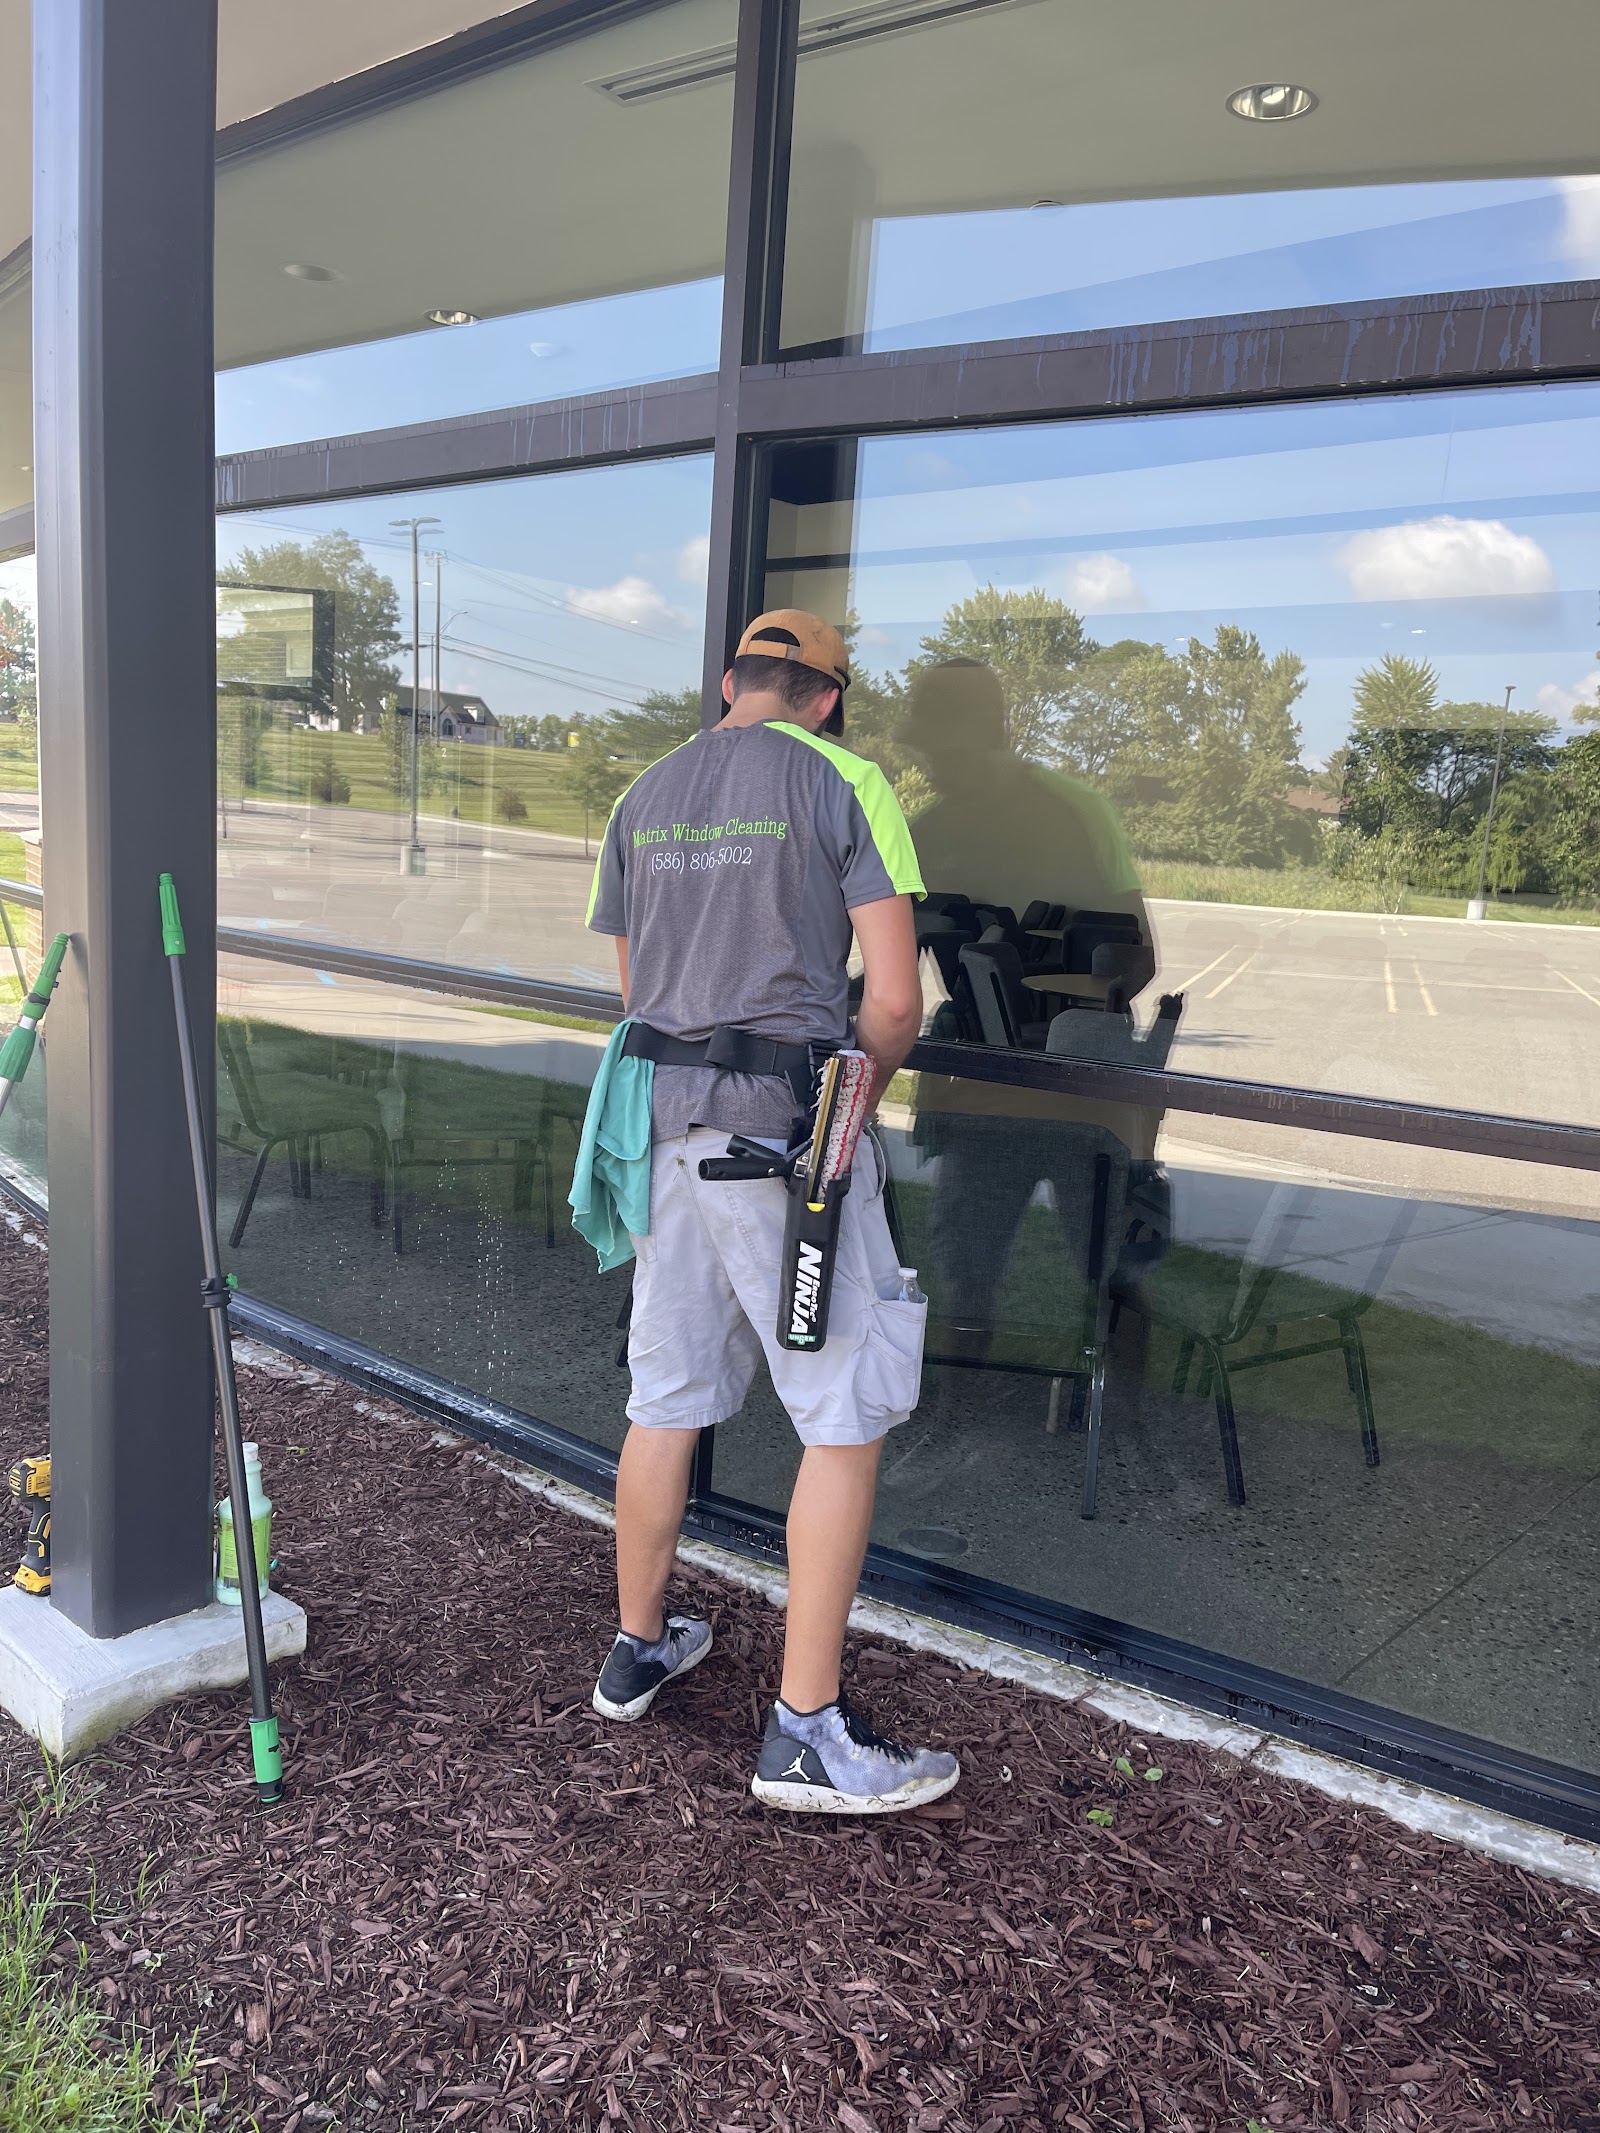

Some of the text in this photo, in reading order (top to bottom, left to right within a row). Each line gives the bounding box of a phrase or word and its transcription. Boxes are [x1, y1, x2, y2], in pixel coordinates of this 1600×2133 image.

[632, 815, 788, 849] Matrix Window Cleaning
[651, 846, 753, 876] (586) 806-5002
[789, 1334, 815, 1344] UNGER
